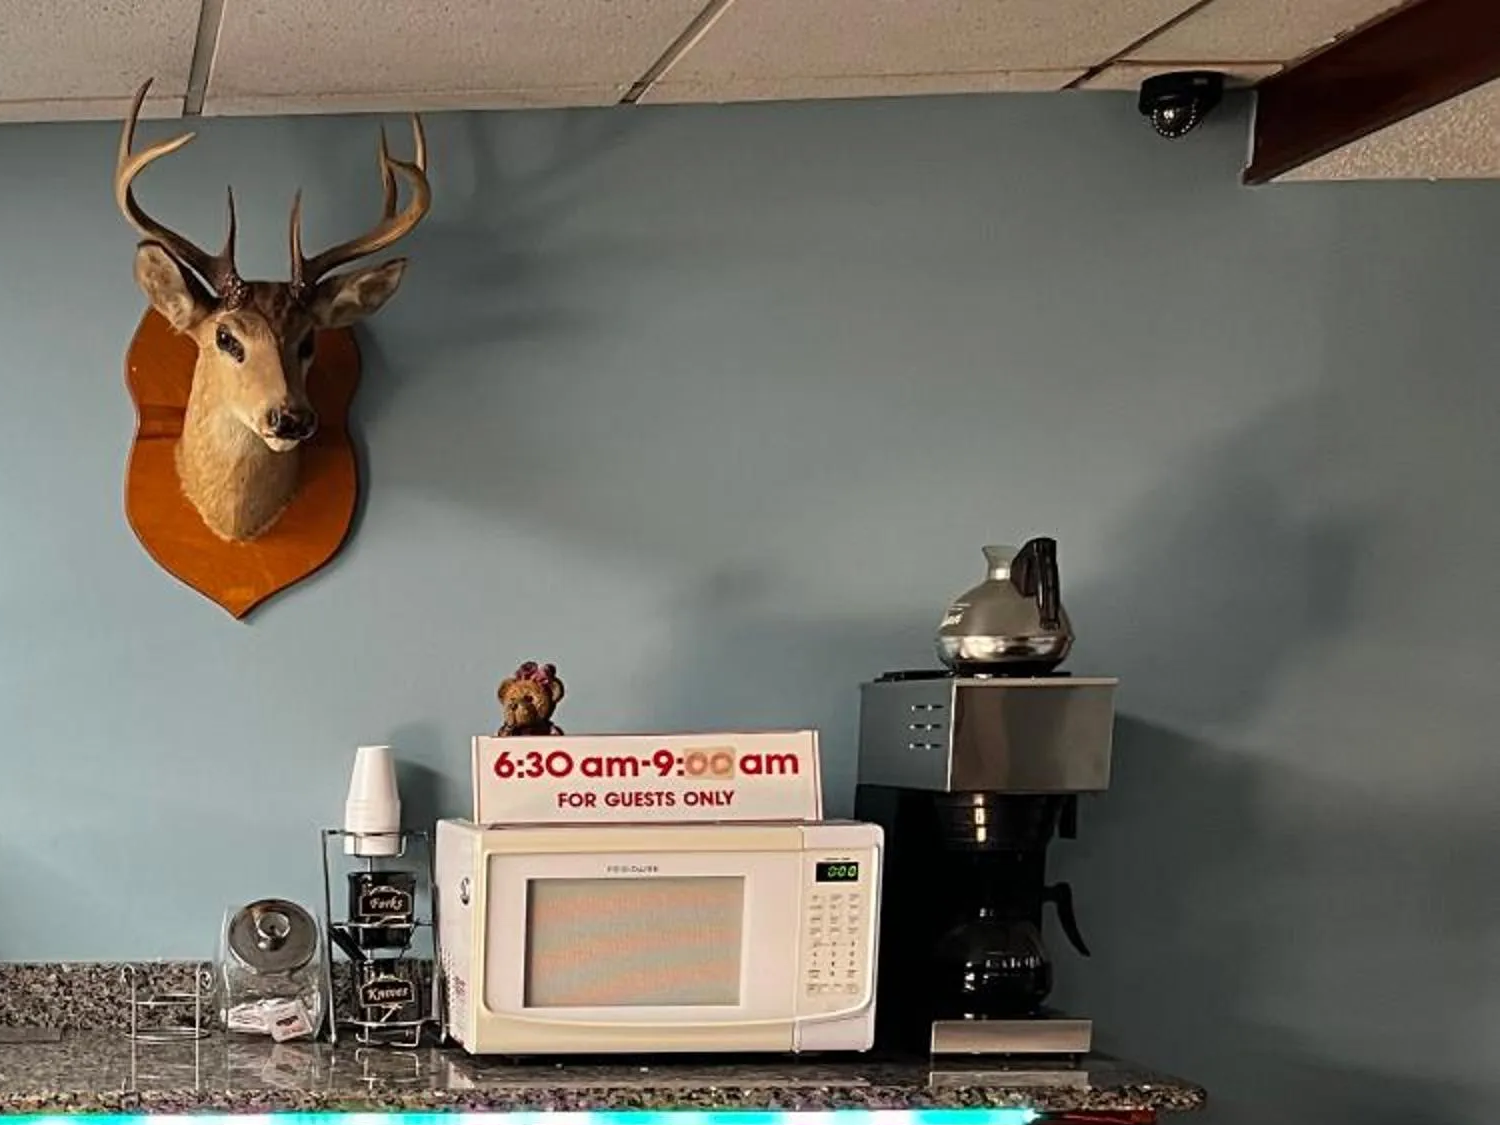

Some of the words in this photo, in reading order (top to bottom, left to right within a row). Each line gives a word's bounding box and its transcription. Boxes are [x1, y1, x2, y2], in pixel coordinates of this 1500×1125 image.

[493, 750, 574, 778] 6:30
[739, 752, 799, 775] am
[558, 791, 597, 808] FOR
[604, 790, 675, 808] GUESTS
[683, 790, 735, 806] ONLY
